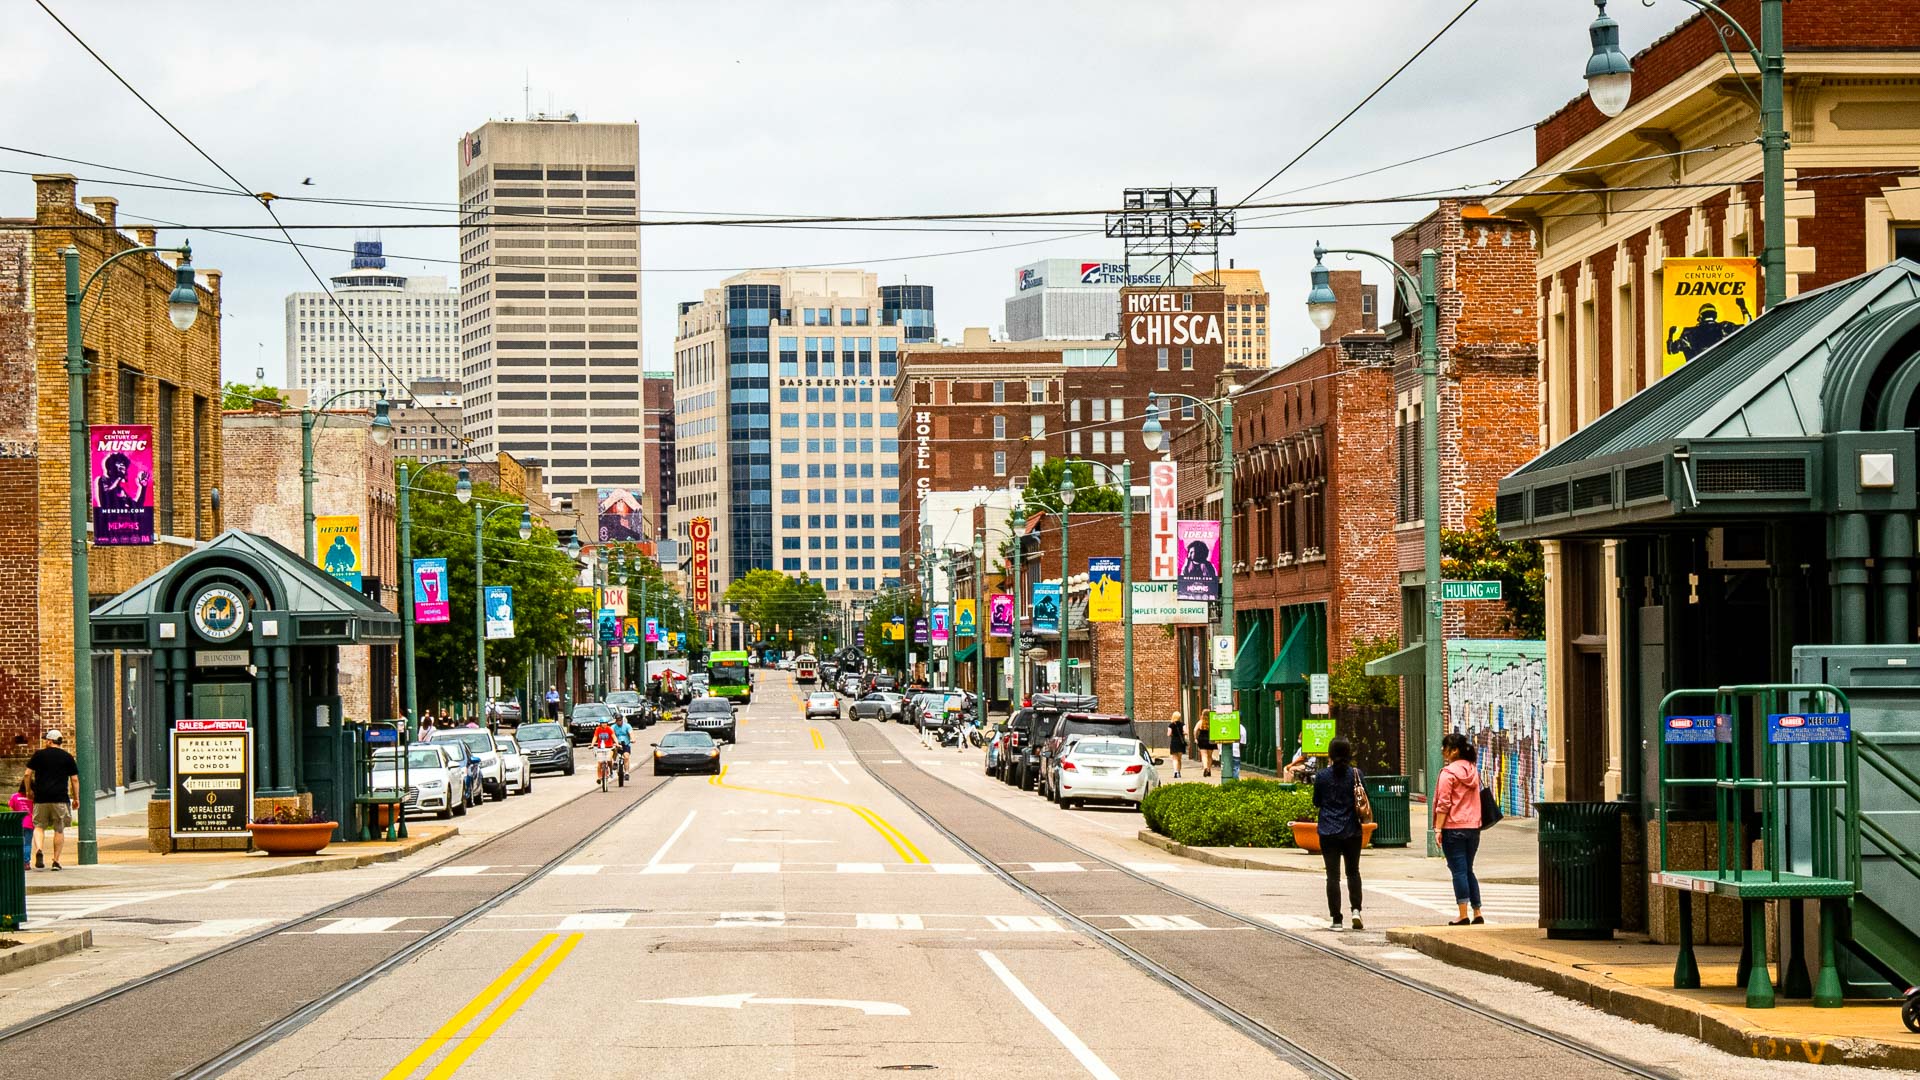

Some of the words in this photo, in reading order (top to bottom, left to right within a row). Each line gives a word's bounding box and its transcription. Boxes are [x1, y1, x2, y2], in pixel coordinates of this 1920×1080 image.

[1102, 263, 1131, 273] FIRST
[1101, 274, 1162, 283] TENNESSEE
[1674, 281, 1746, 296] DANCE
[1128, 294, 1181, 312] HOTEL
[1130, 314, 1223, 345] CHISCA
[97, 440, 147, 451] MUSIC
[916, 412, 931, 469] HOTEL
[108, 522, 139, 531] MEMPHIS
[1153, 465, 1174, 577] SMITH
[1183, 530, 1214, 539] IDEAS
[694, 524, 707, 611] ORPHEUM
[1446, 584, 1484, 598] HULING
[1486, 586, 1499, 594] AVE
[196, 592, 213, 610] MAIN
[218, 590, 241, 609] STREET
[179, 721, 203, 729] SALES
[215, 721, 244, 729] RENTAL
[1808, 716, 1824, 725] KEEP
[1826, 716, 1839, 725] OFF
